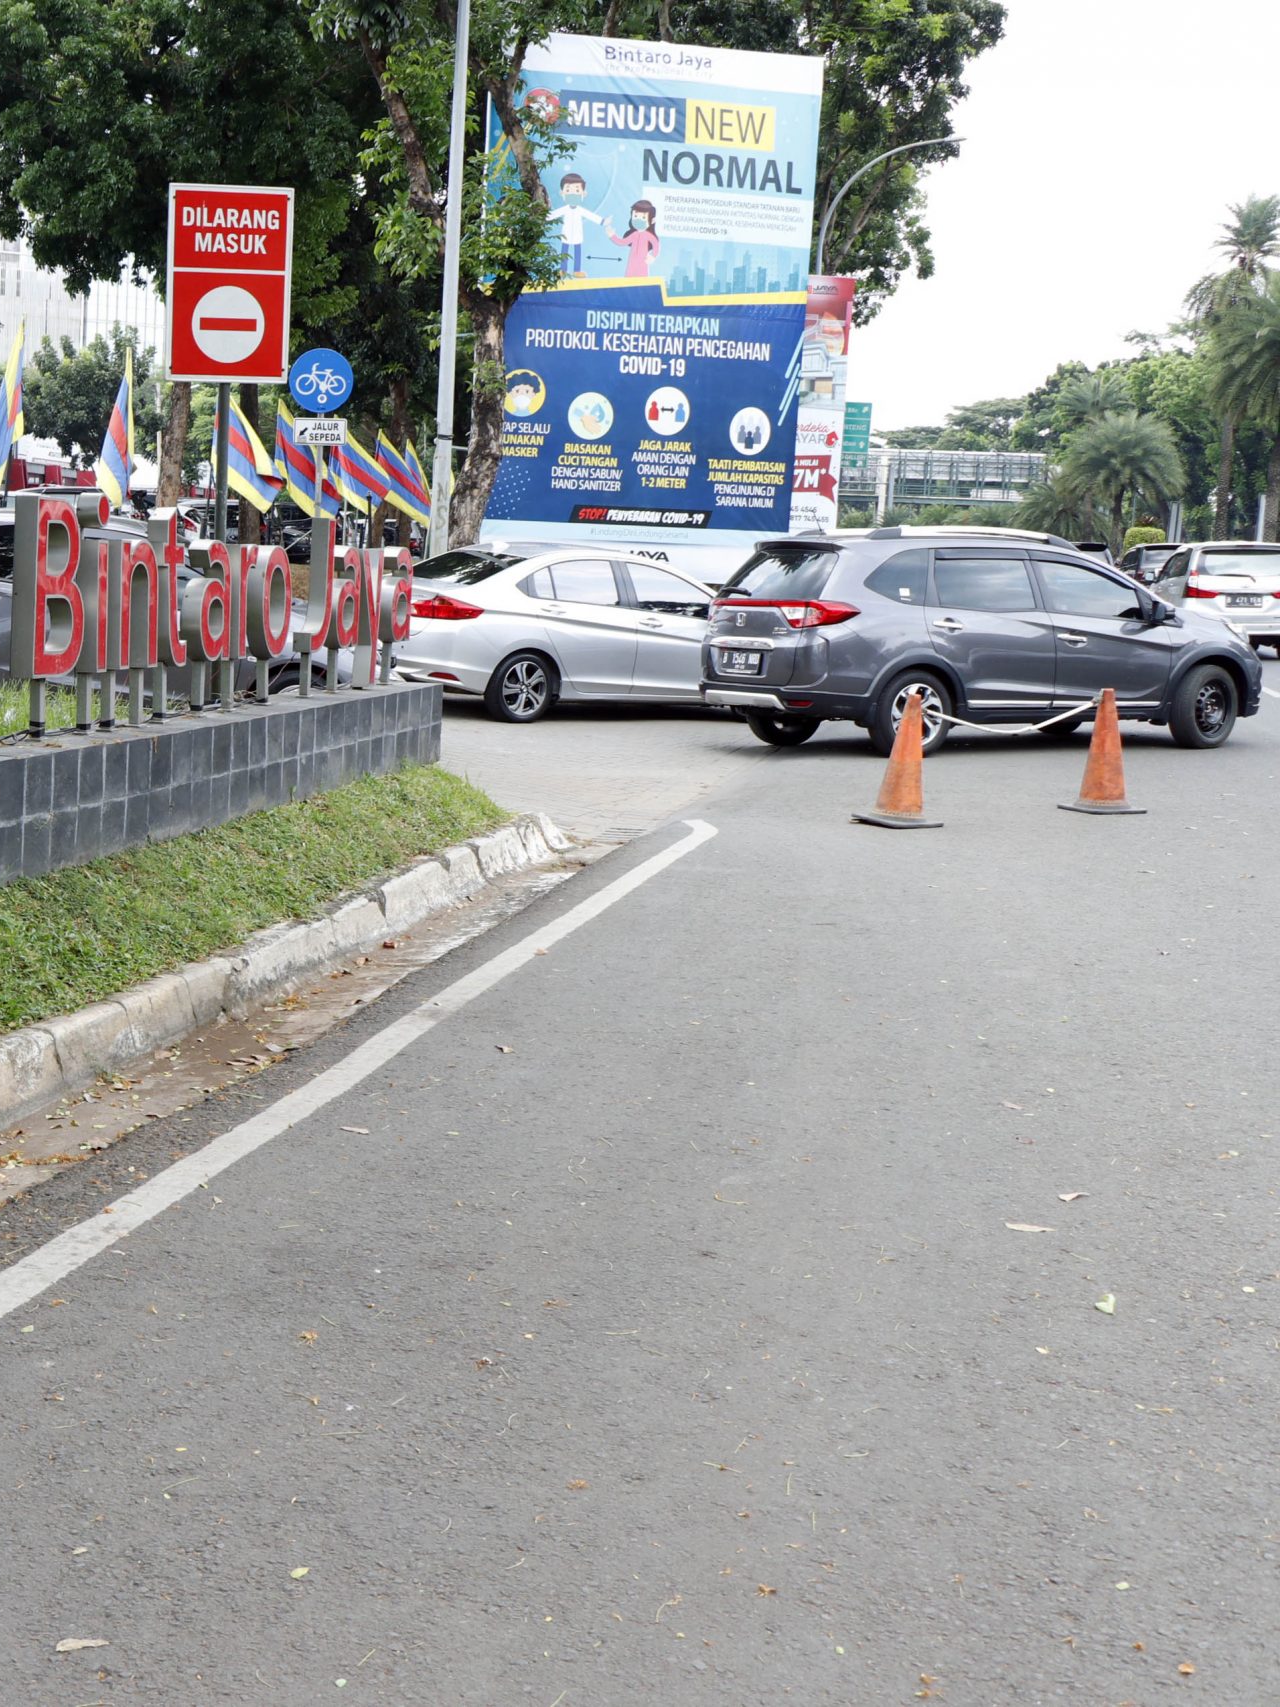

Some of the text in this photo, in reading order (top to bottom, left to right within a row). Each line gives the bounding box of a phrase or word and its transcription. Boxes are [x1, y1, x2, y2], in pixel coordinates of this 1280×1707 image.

[605, 46, 712, 70] Bintaro Jaya
[568, 100, 766, 144] MENUJU NEW
[642, 149, 802, 195] NORMAL
[182, 205, 280, 230] DILARANG
[699, 226, 728, 235] COVID-19
[194, 232, 267, 255] MASUK
[586, 310, 719, 337] DISIPLIN TERAPKAN
[526, 328, 770, 361] PROTOKOL KESEHATAN PENCEGAHAN
[312, 422, 339, 431] JALUR
[519, 422, 551, 434] SELALU
[309, 433, 341, 441] SEPEDA
[501, 434, 544, 445] UNAKAN
[564, 443, 611, 455] BIASAKAN
[638, 439, 691, 452] JAGA JARAK
[558, 455, 618, 467] CUCI TANGAN
[632, 451, 696, 465] AMAN DENGAN
[637, 464, 689, 477] ORANG LAIN
[708, 459, 786, 472] TAATI PEMBATASAN
[551, 466, 623, 480] DENGAN SABUN/
[707, 471, 785, 485] JUMLAH KAPASITAS
[551, 479, 621, 491] HAND SANITIZER
[641, 477, 686, 489] 1-2 METER
[714, 484, 775, 496] PENGUNJUNG DI
[715, 497, 774, 509] SARANA UMUM
[578, 508, 705, 524] STOP! PENYEBARAN COVID-19
[630, 550, 670, 562] AYA
[10, 492, 293, 679] Bintaro
[293, 517, 414, 689] Jaya
